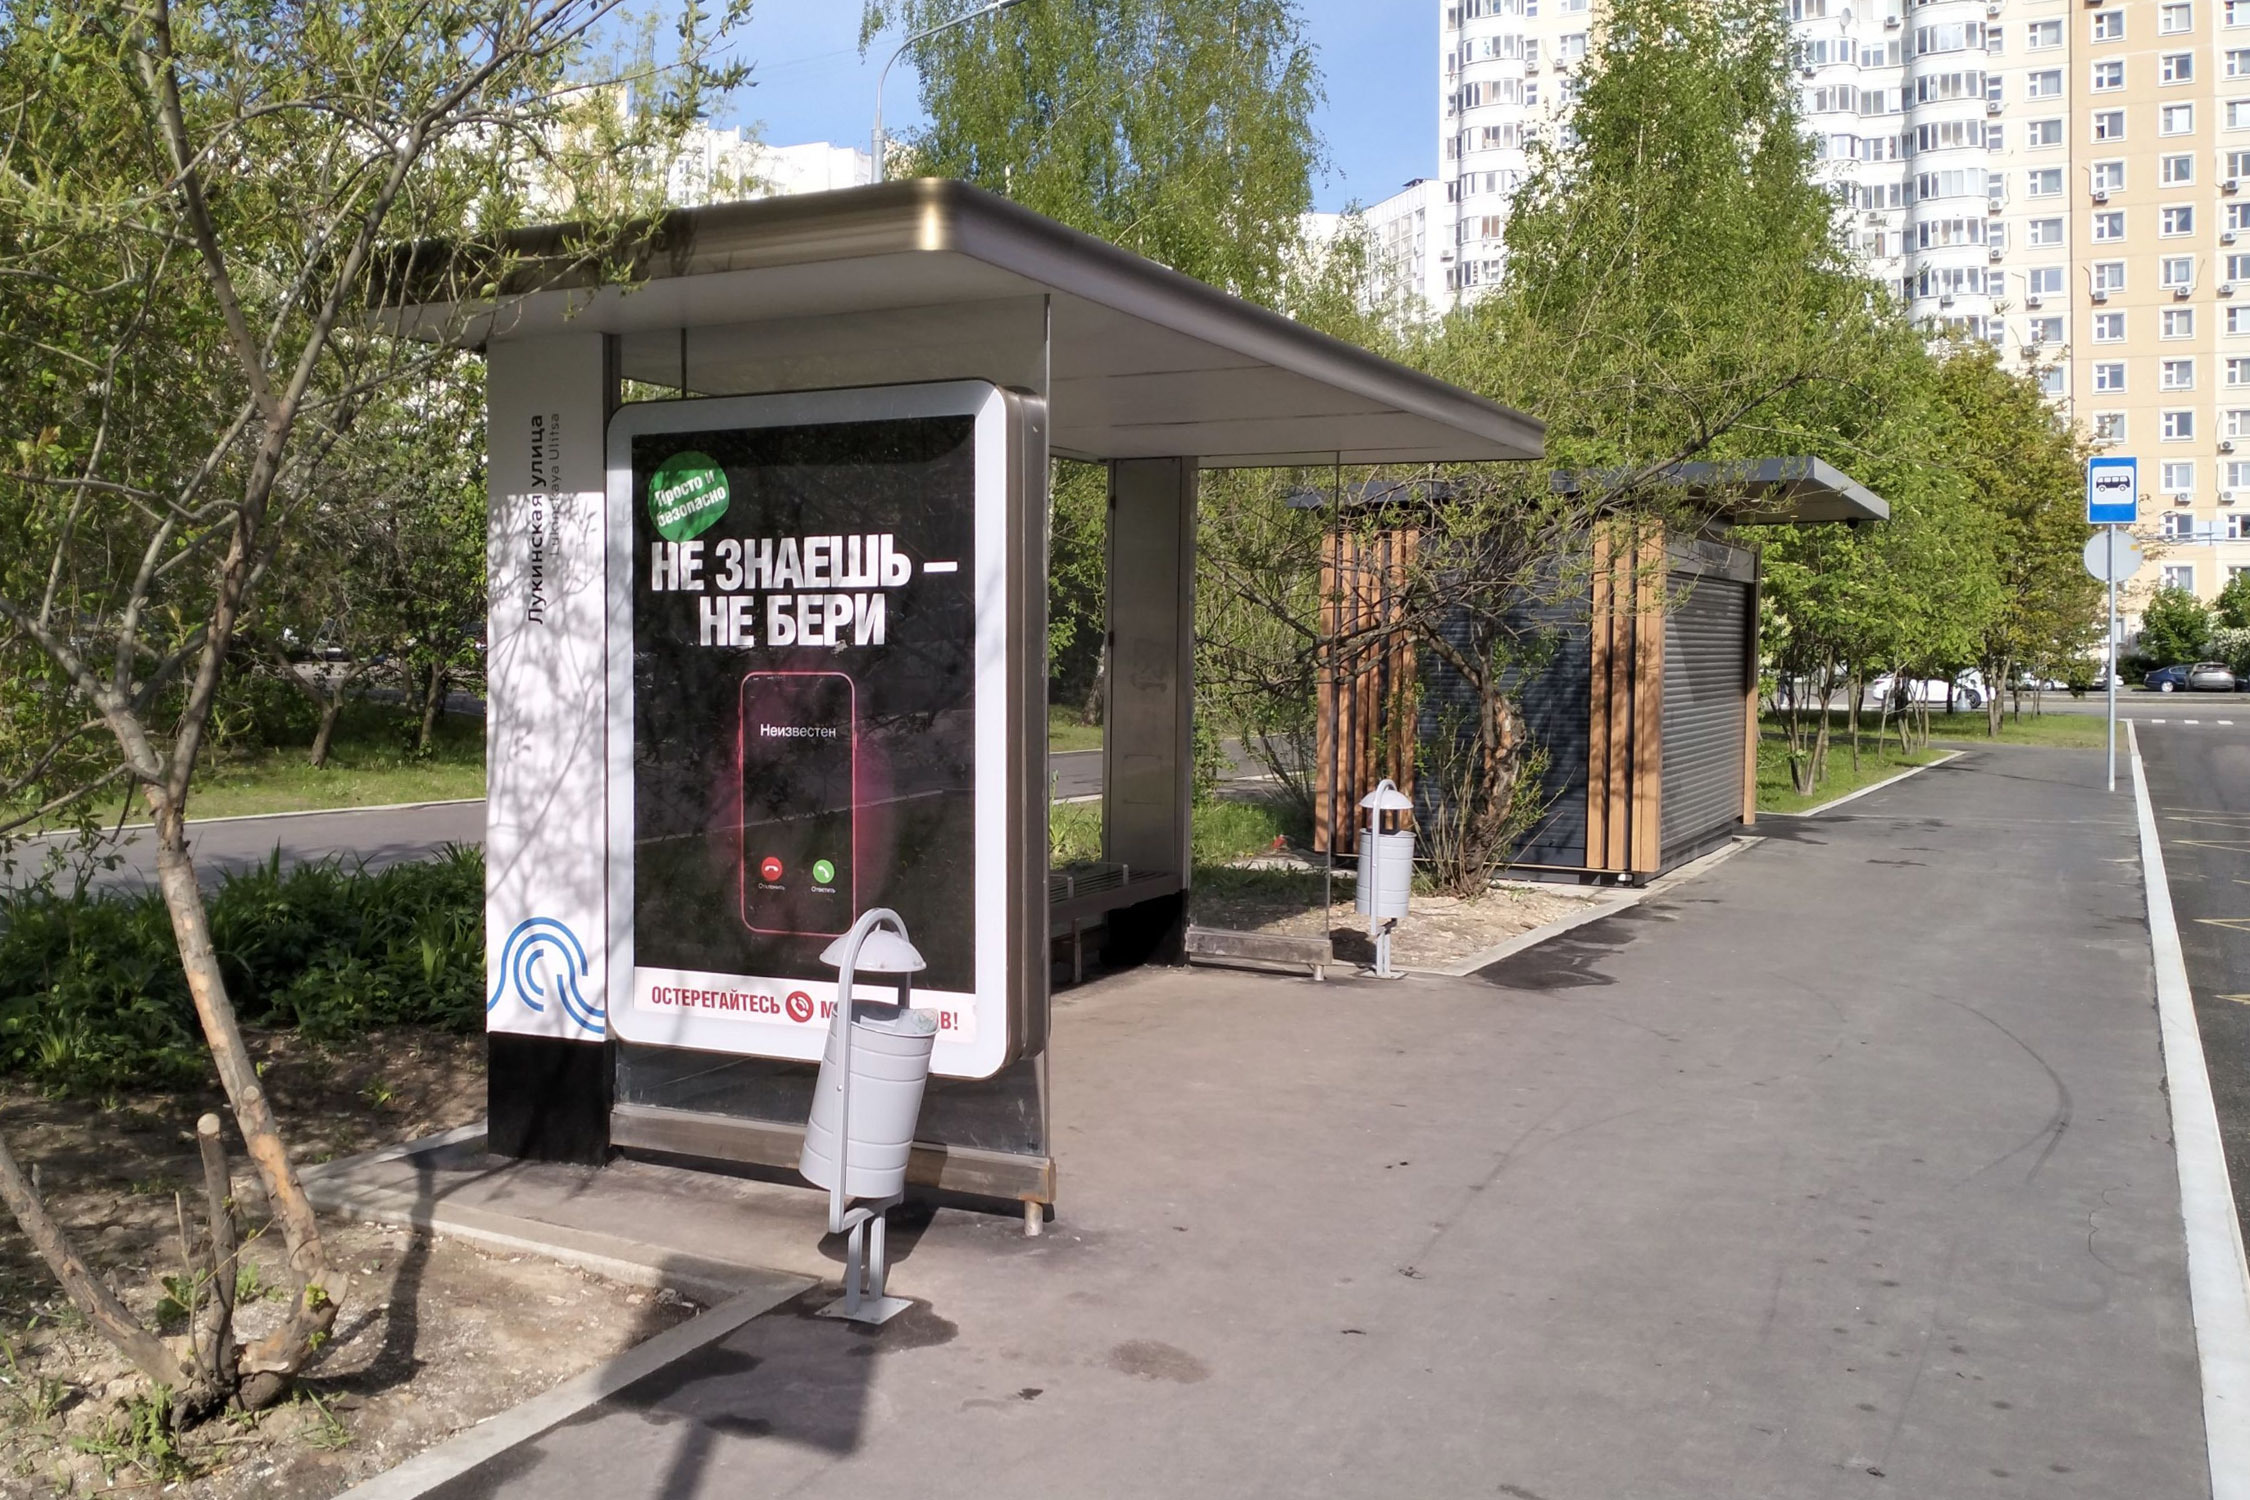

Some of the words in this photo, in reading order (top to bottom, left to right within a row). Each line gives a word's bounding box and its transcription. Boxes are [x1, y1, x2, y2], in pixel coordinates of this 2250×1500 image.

[530, 414, 546, 488] улица
[548, 413, 560, 460] Ulitsa
[549, 464, 562, 556] Lukinskaya
[654, 475, 703, 507] Просто
[704, 469, 715, 484] и
[656, 486, 727, 527] безопасно
[528, 494, 547, 625] Лукинская
[651, 540, 705, 591] НЕ
[714, 533, 912, 590] ЗНАЕШЬ
[699, 595, 755, 647] НЕ
[766, 593, 885, 646] БЕРИ
[760, 723, 837, 738] Неизвестен
[651, 985, 781, 1015] ОСТЕРЕГАЙТЕСЬ
